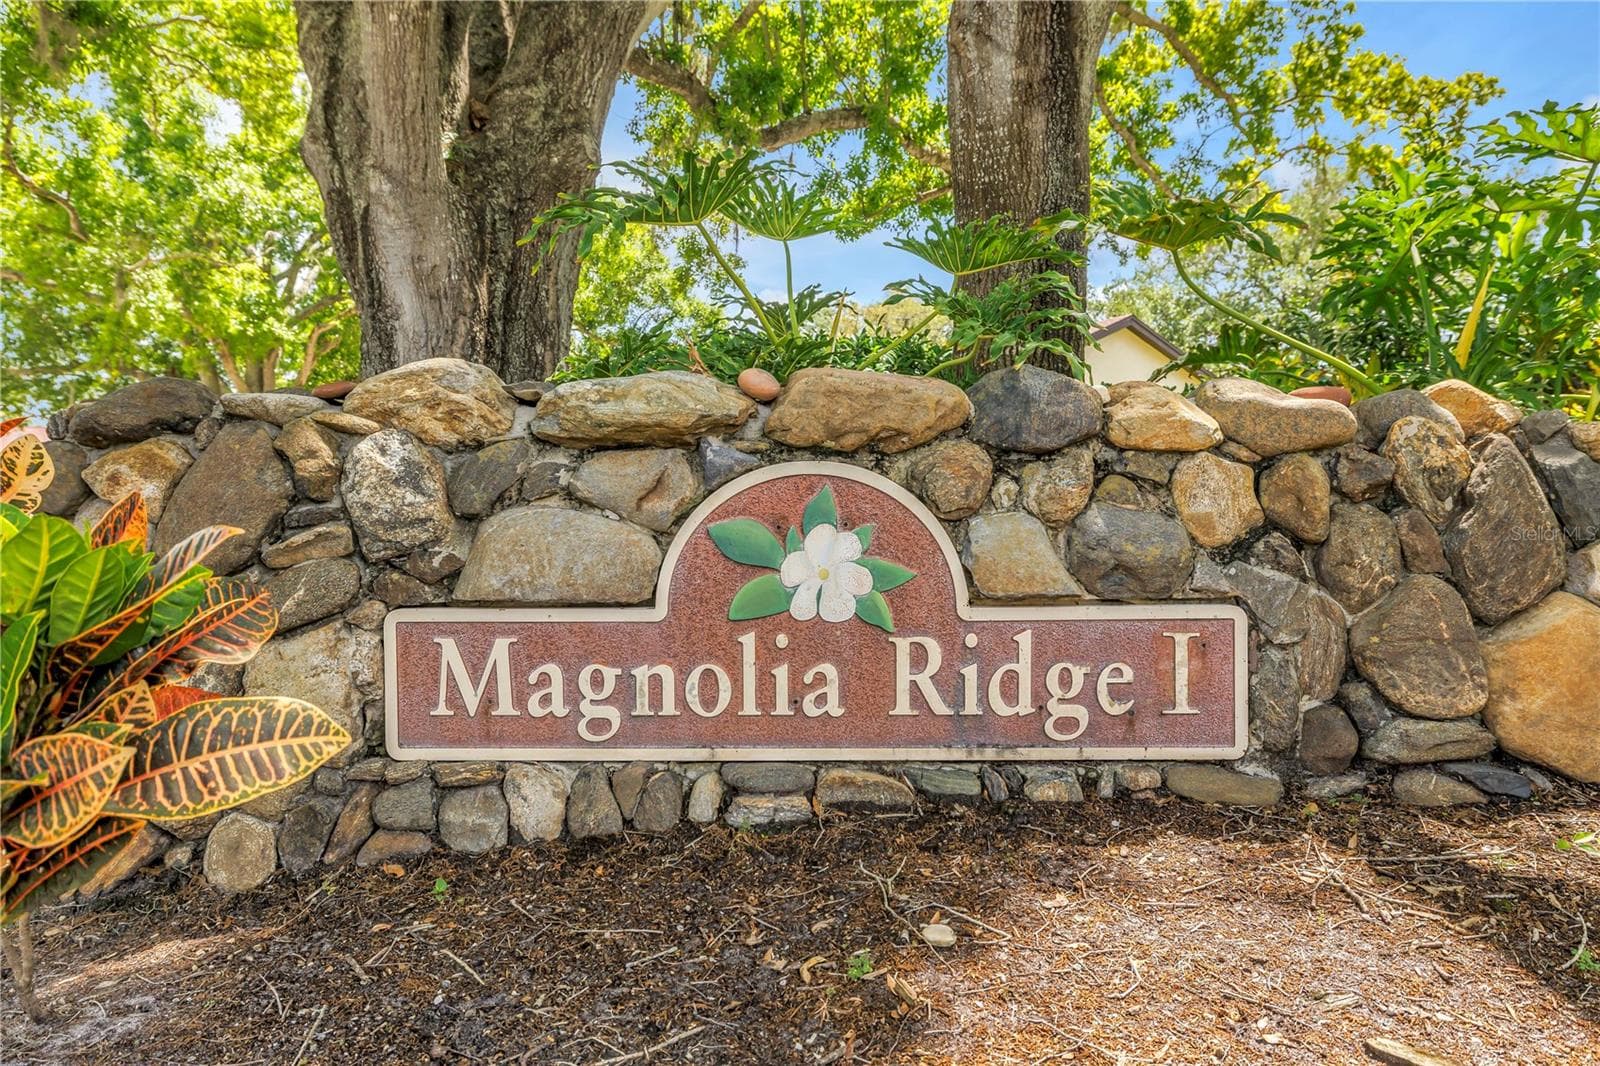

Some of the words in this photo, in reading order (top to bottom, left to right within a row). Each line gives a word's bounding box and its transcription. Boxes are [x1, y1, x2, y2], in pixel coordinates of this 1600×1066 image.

[429, 631, 845, 742] Magnolia
[888, 629, 1135, 742] Ridge
[1161, 631, 1201, 715] I
